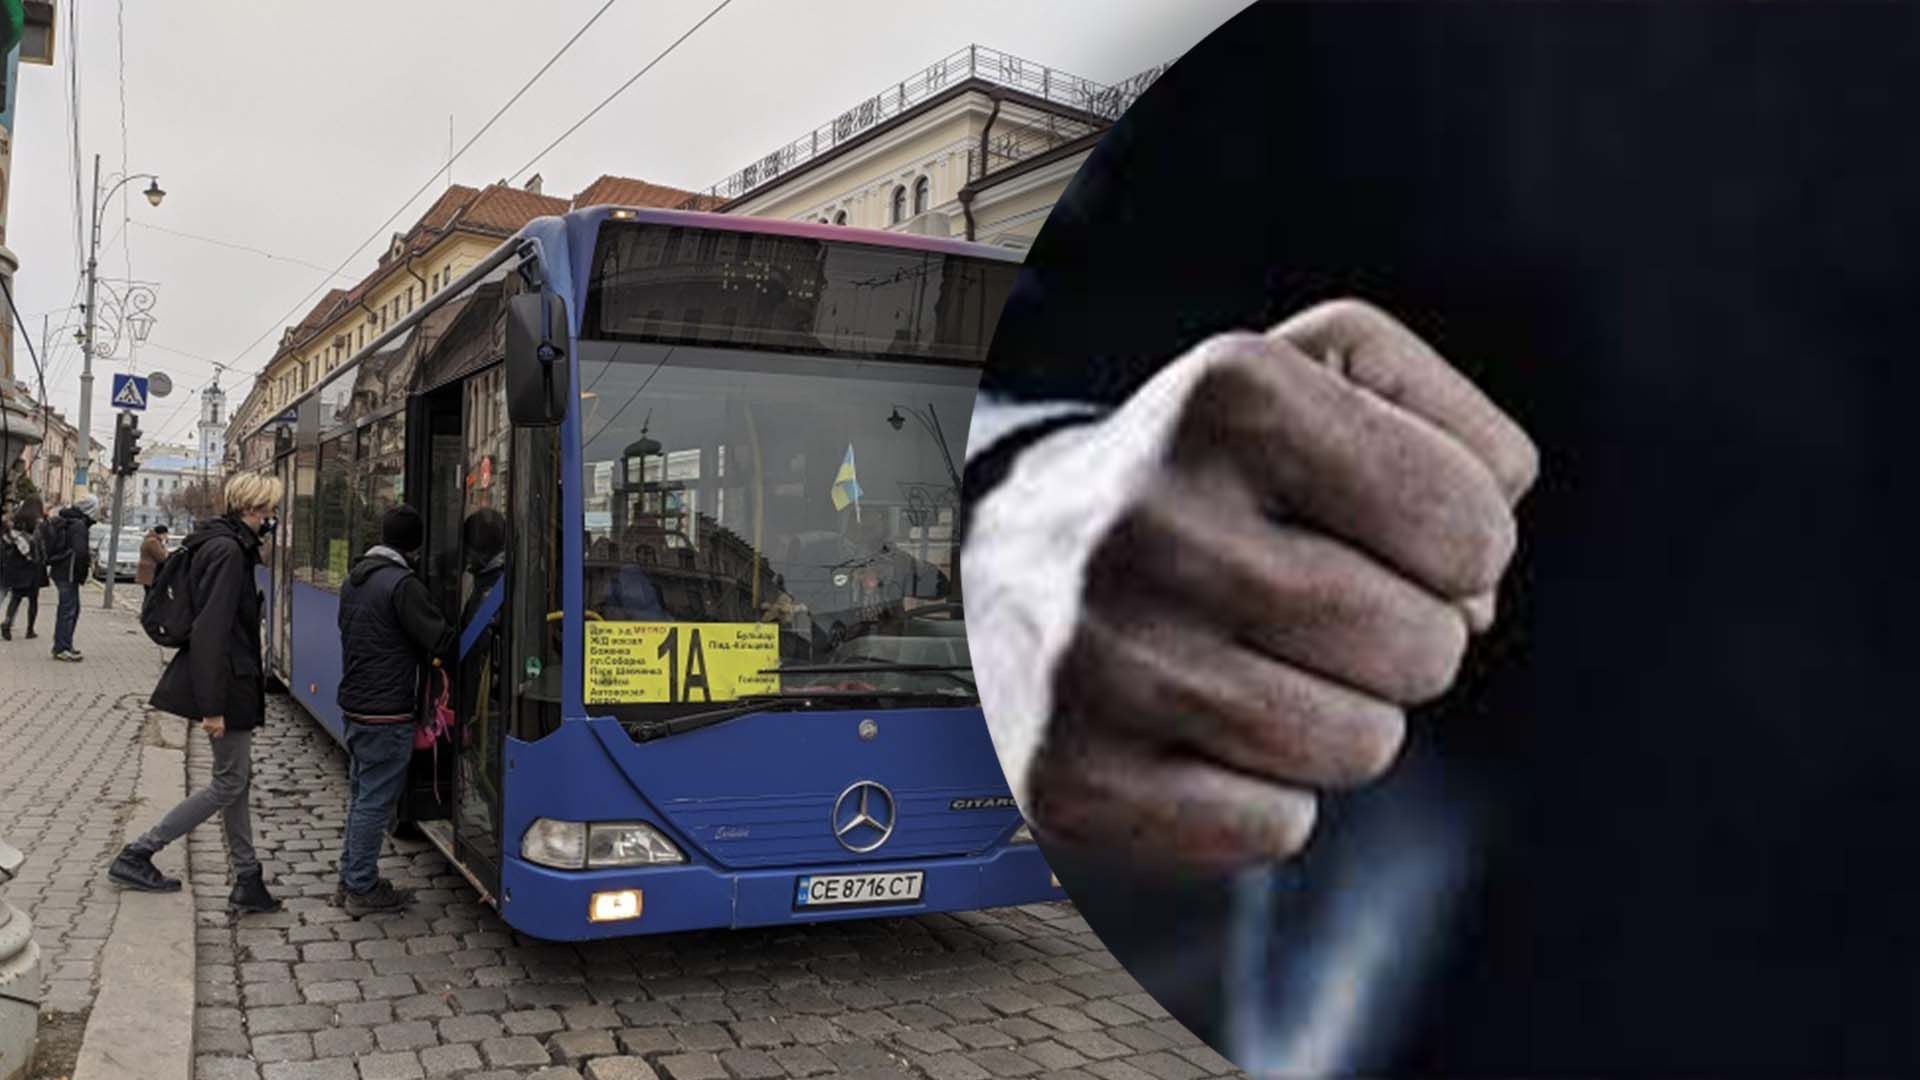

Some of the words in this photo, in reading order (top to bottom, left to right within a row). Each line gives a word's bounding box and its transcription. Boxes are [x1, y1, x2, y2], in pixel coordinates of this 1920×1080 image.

[811, 880, 839, 900] CE
[842, 877, 885, 898] 8716
[890, 875, 918, 895] CT
